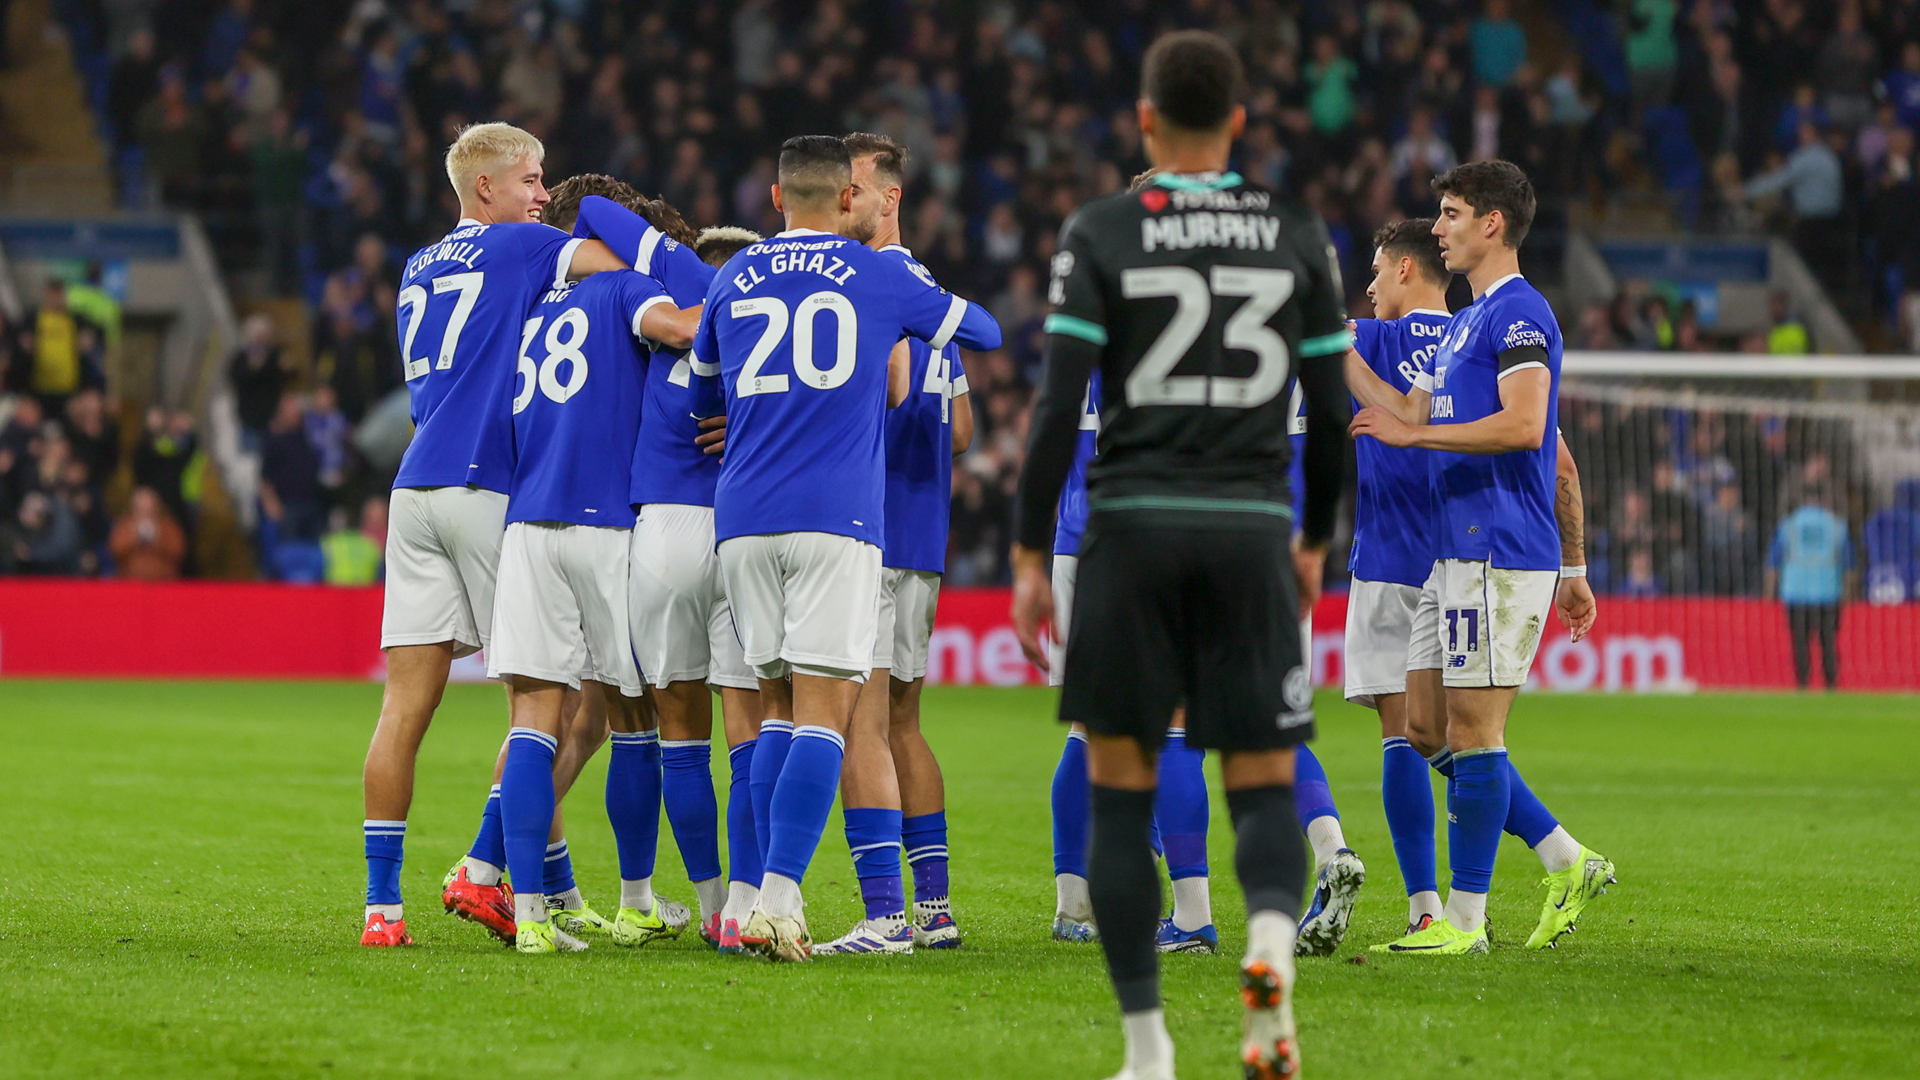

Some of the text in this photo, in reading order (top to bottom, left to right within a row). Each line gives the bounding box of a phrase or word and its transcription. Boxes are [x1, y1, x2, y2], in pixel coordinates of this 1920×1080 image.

[746, 240, 847, 256] QUINNBET
[1141, 212, 1280, 252] MURPHY
[409, 242, 484, 279] COLWILL
[733, 252, 857, 294] EL GHAZI
[542, 290, 573, 303] NG
[399, 271, 484, 382] 27
[731, 291, 857, 399] 20
[1120, 265, 1295, 408] 23
[923, 348, 952, 424] 4
[1446, 609, 1478, 651] 11
